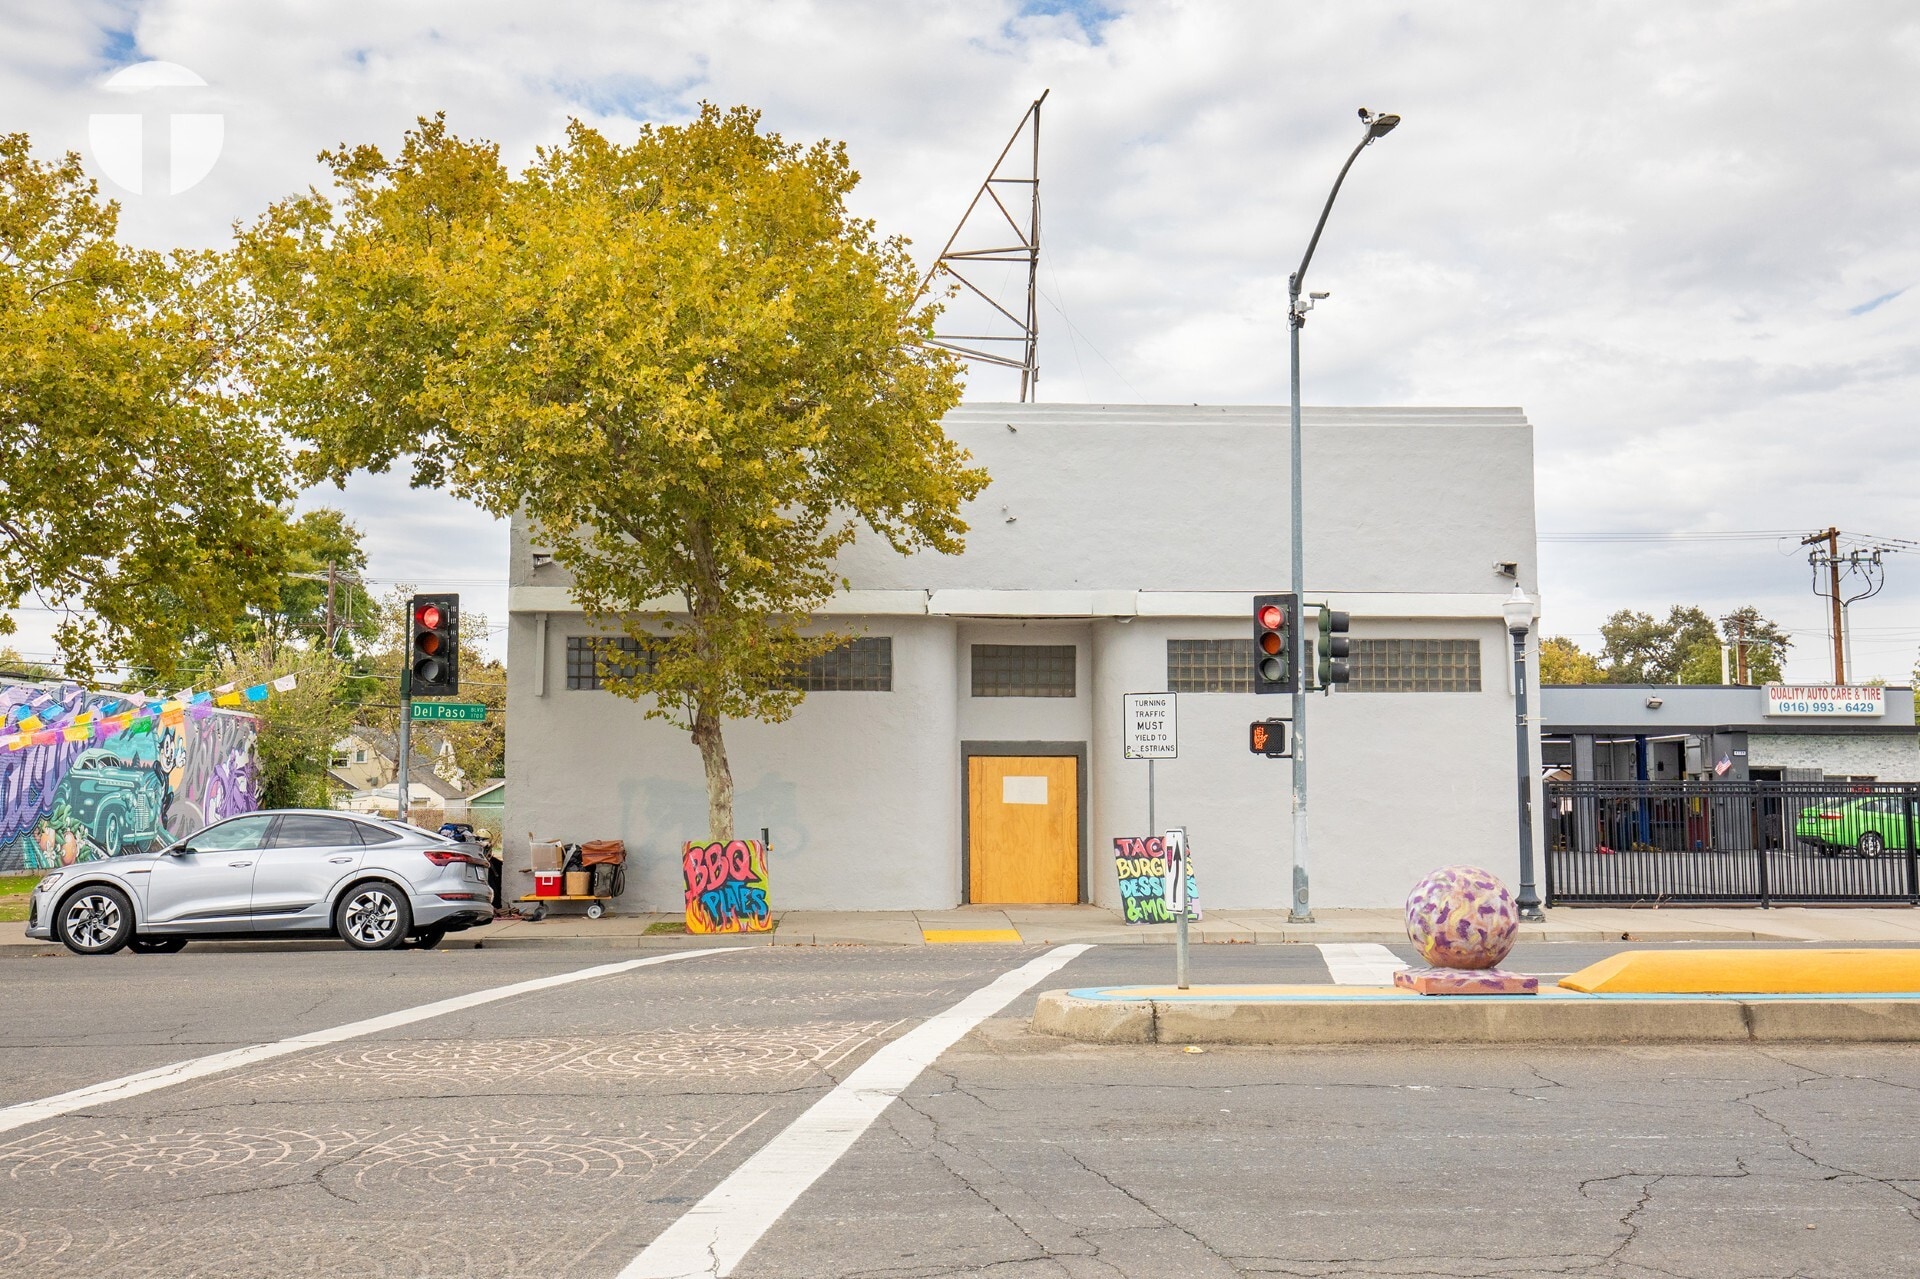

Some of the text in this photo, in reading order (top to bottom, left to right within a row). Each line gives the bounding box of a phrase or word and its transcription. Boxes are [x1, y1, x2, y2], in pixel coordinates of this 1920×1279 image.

[1770, 687, 1881, 700] QUALITY AUTO CARE & TIRE
[1134, 699, 1166, 707] TURNING
[1779, 702, 1809, 713] (916)
[1813, 702, 1834, 712] 993
[1845, 702, 1874, 712] 6429
[414, 705, 466, 718] Del Paso
[1135, 710, 1166, 718] TRAFFIC
[1137, 721, 1164, 730] MUST
[1126, 744, 1175, 752] PESTRIANS
[684, 840, 759, 902] BBQ
[701, 880, 768, 918] PLATES
[1127, 896, 1143, 921] &
